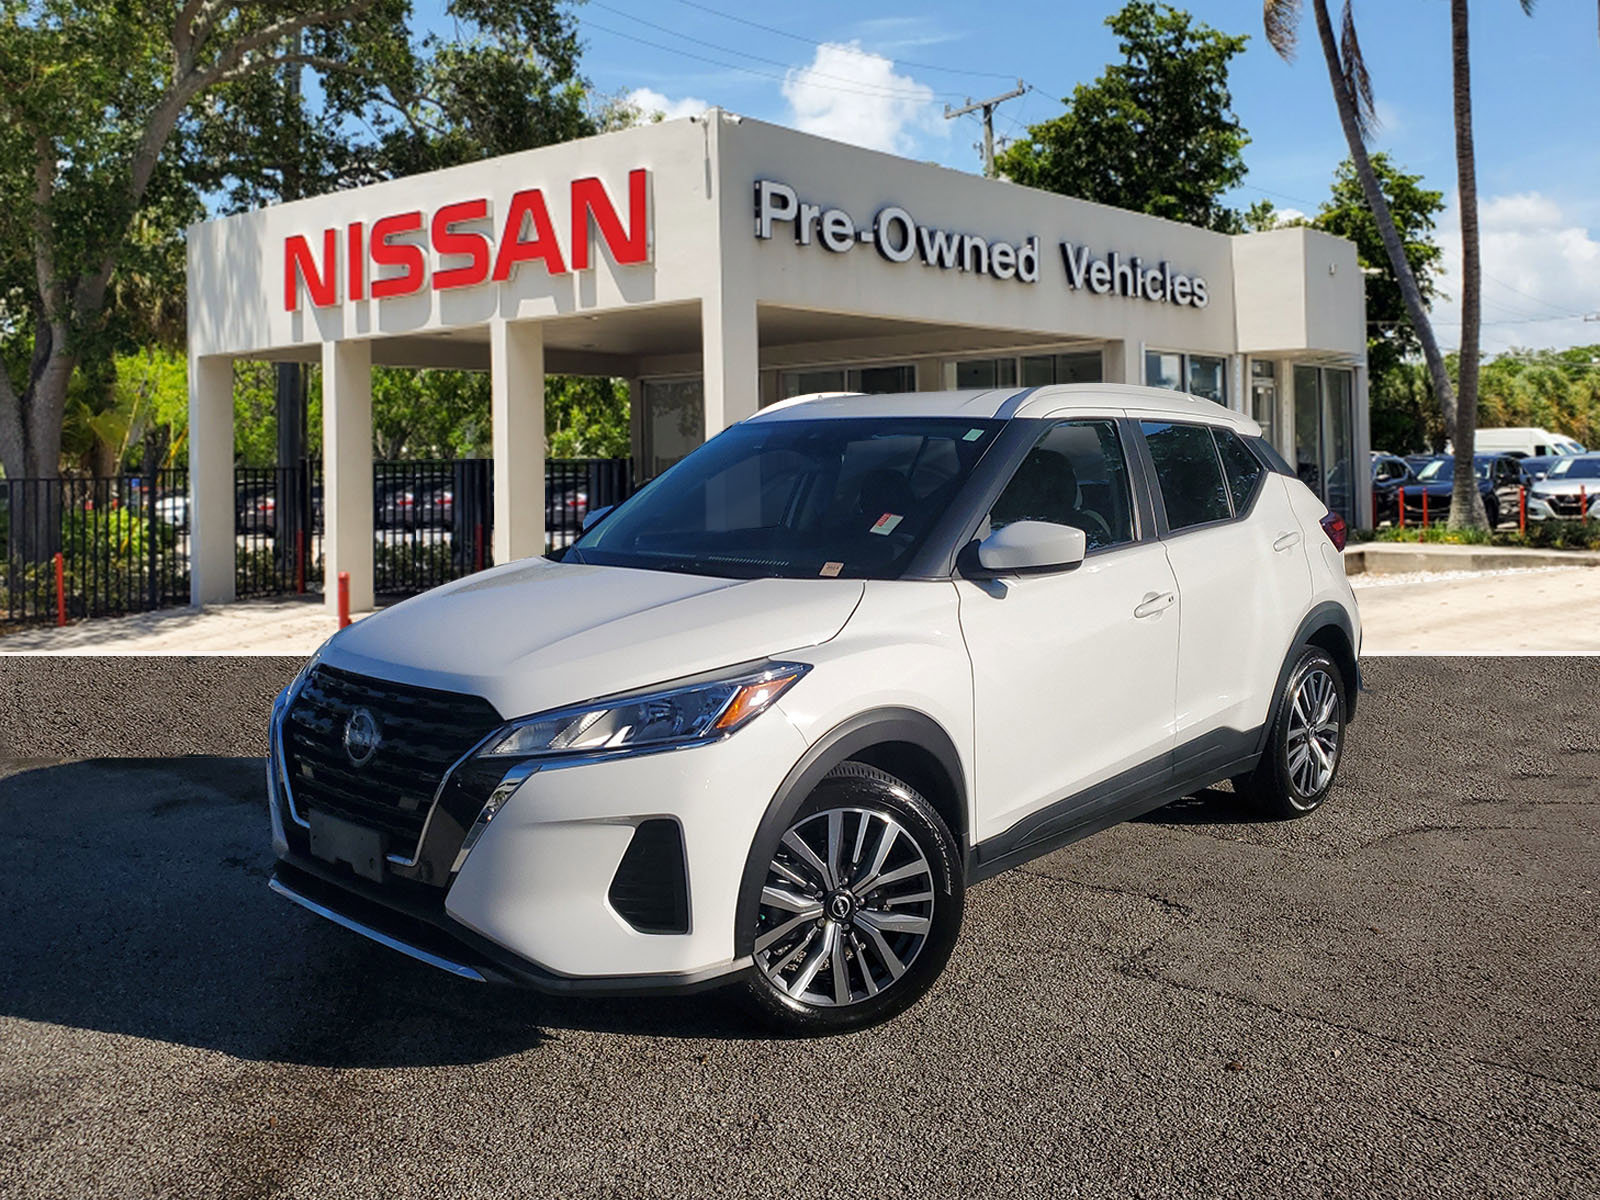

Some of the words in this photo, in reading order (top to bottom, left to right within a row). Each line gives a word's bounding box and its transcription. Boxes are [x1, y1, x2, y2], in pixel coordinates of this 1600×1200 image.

[284, 168, 650, 312] NISSAN
[755, 179, 1040, 283] Pre-Owned
[1060, 241, 1209, 309] Vehicles
